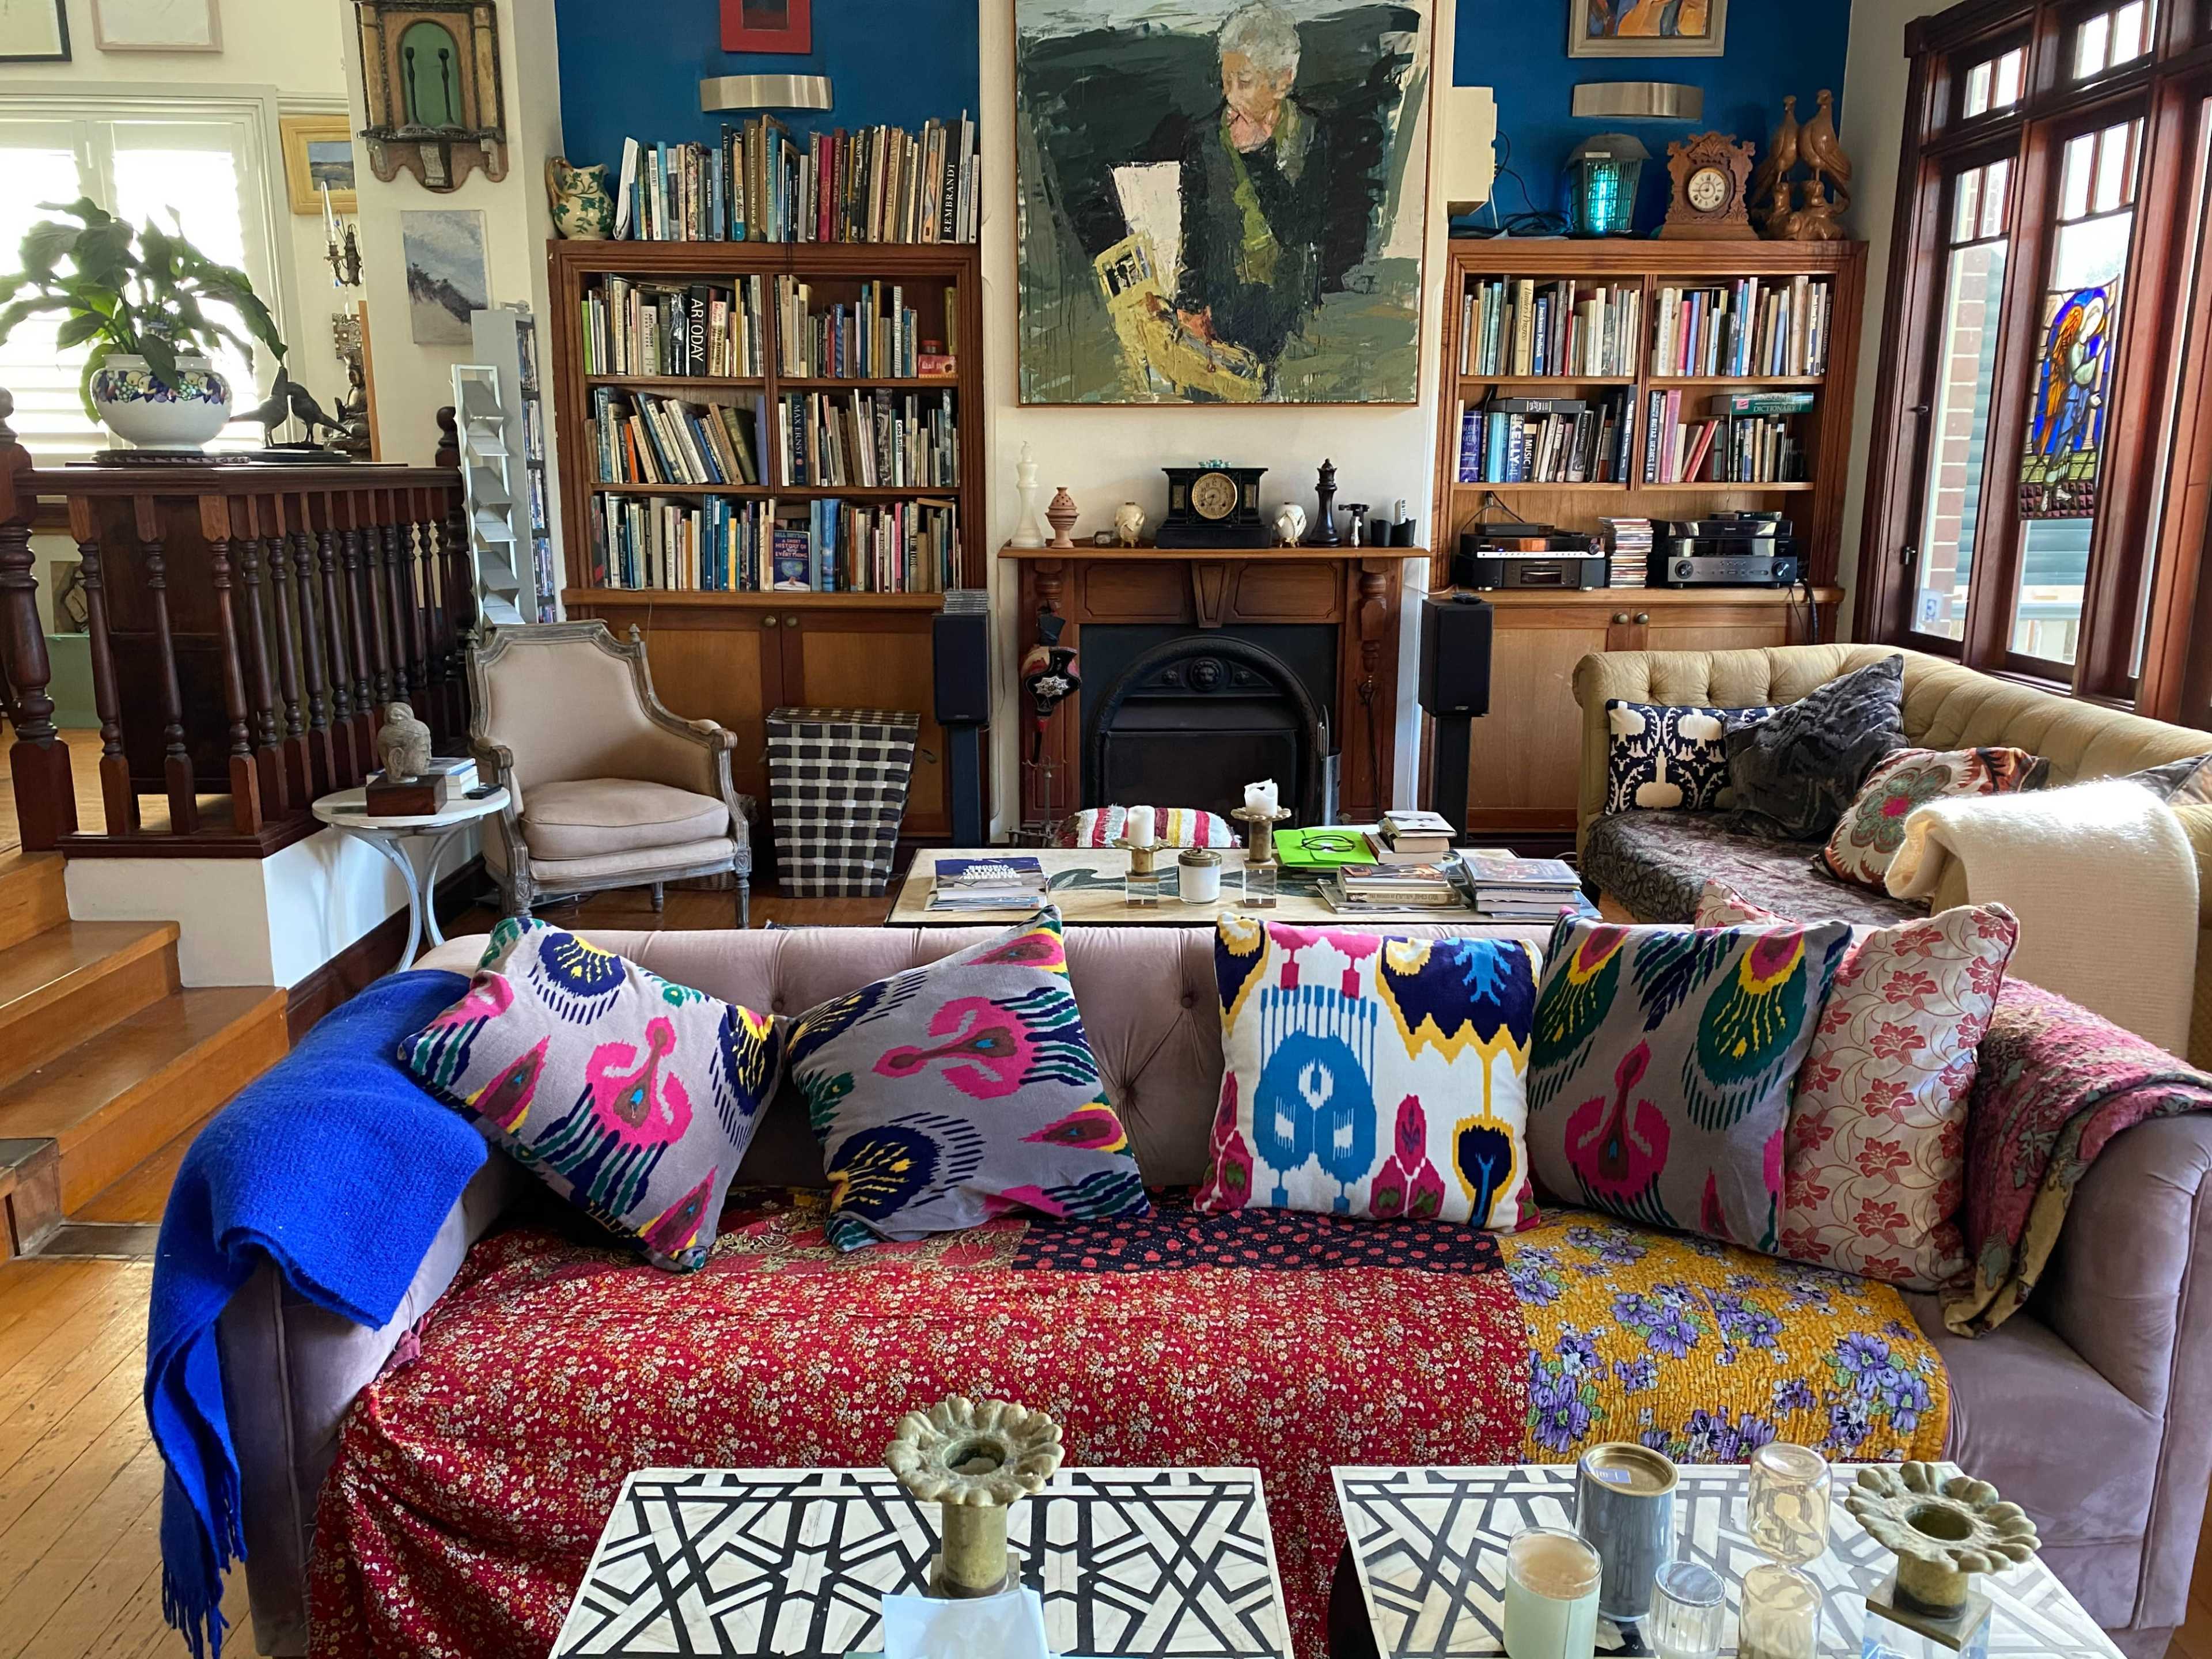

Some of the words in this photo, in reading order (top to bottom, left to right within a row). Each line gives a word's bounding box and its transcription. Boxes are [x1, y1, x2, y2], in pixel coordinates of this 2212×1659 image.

[887, 166, 896, 207] LEONARDO
[944, 163, 955, 233] REMBRANDT
[691, 298, 704, 362] ARTODAY
[793, 404, 801, 425] MAX
[1578, 428, 1586, 452] RICHARDS
[1650, 418, 1658, 438] GUITAR
[1510, 421, 1522, 464] KELLY
[1523, 440, 1532, 465] MUSIC
[910, 537, 918, 547] DE
